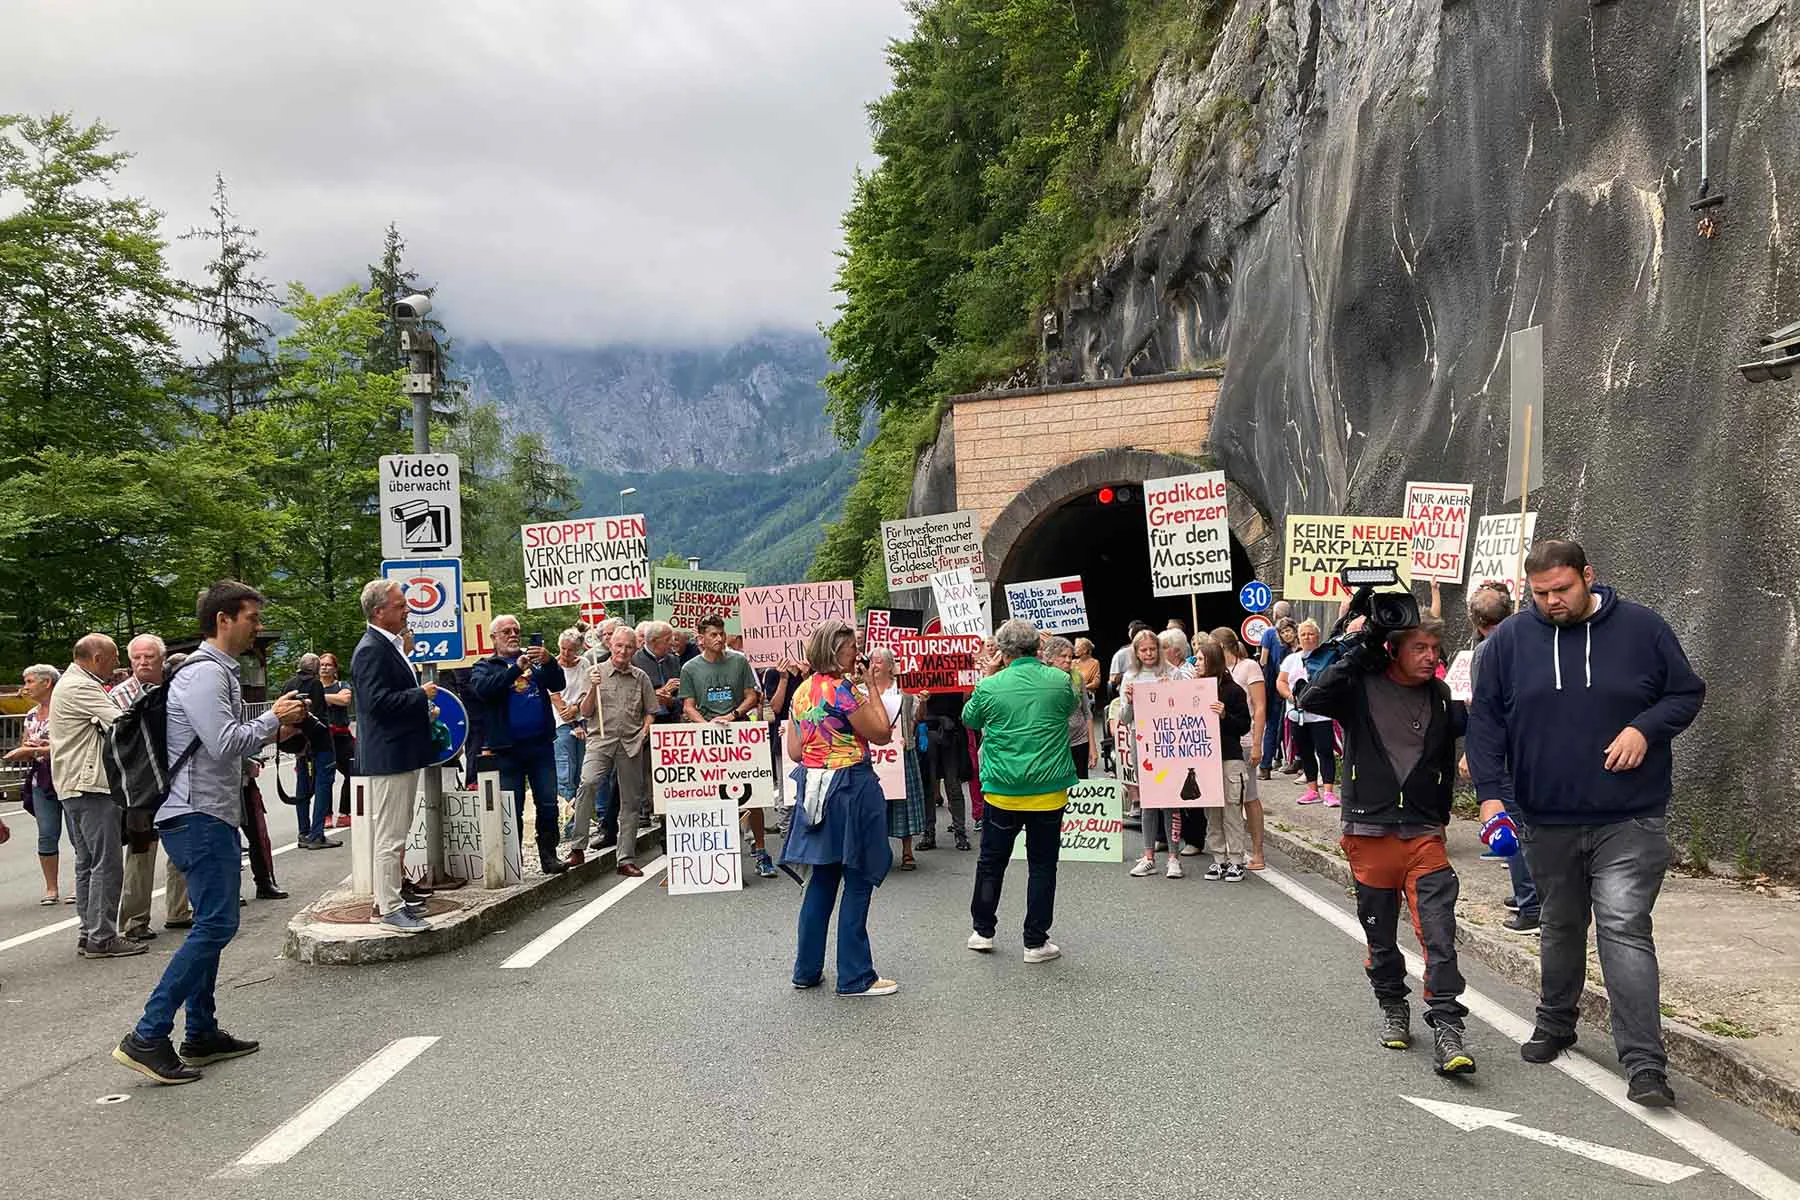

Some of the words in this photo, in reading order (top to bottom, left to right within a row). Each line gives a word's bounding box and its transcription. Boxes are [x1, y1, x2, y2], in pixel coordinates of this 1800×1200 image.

[389, 459, 449, 478] Video
[388, 479, 452, 493] überwacht
[1147, 479, 1225, 506] radikale
[1411, 493, 1434, 505] NUR
[1437, 495, 1471, 508] MEHR
[1149, 505, 1227, 527] Grenzen
[1410, 503, 1465, 523] LÄRM
[526, 522, 596, 548] STOPPT
[606, 518, 647, 540] DEN
[886, 526, 901, 539] Für
[903, 521, 949, 537] Investoren
[952, 515, 971, 530] und
[1150, 527, 1177, 548] für
[1185, 524, 1218, 544] den
[1293, 523, 1345, 539] KEINE
[1352, 525, 1413, 541] NEUEN
[1480, 518, 1521, 537] WELT
[887, 531, 974, 551] Geschäftemacher
[1293, 538, 1408, 557] PARKPLÄTZE
[525, 538, 649, 568] VERKEHRSWAHN
[888, 549, 900, 563] ist
[902, 545, 943, 562] Hallstatt
[944, 546, 960, 556] nur
[963, 541, 978, 552] ein
[939, 555, 952, 569] für
[954, 556, 970, 566] uns
[971, 550, 982, 563] ist
[1411, 552, 1459, 571] RUST
[567, 569, 584, 585] er
[591, 558, 648, 582] macht
[1289, 557, 1350, 577] PLATZ
[1471, 559, 1505, 577] AM
[891, 576, 904, 586] es
[905, 571, 929, 584] aber
[934, 570, 963, 588] VIEL
[544, 587, 581, 605] uns
[589, 576, 648, 602] krank
[744, 588, 784, 606] WAS
[817, 583, 844, 600] EIN
[1031, 588, 1044, 599] bis
[1046, 588, 1058, 602] zu
[1245, 587, 1267, 607] 30
[765, 598, 852, 625] HALLSTATT
[1010, 598, 1038, 611] 13000
[1037, 595, 1078, 608] Touristen
[407, 620, 441, 629] RADIO
[868, 611, 889, 627] ES
[408, 640, 449, 659] 9.4
[901, 638, 981, 656] TOURISMUS
[897, 671, 955, 689] TOURISMUS
[1152, 717, 1174, 732] VIEL
[1176, 713, 1207, 730] LÄRM
[653, 730, 696, 750] JETZT
[702, 728, 734, 746] EINE
[1153, 731, 1177, 745] UND
[1178, 729, 1213, 744] MÜLL
[661, 745, 752, 766] BREMSUNG
[1154, 744, 1176, 759] FÜR
[1178, 742, 1213, 759] NICHTS
[653, 767, 697, 784] ODER
[700, 764, 727, 782] wir
[728, 766, 773, 780] werden
[663, 784, 718, 799] überrollt
[670, 808, 730, 829] WIRBEL
[668, 829, 735, 853] TRUBEL
[671, 852, 741, 885] FRUST
